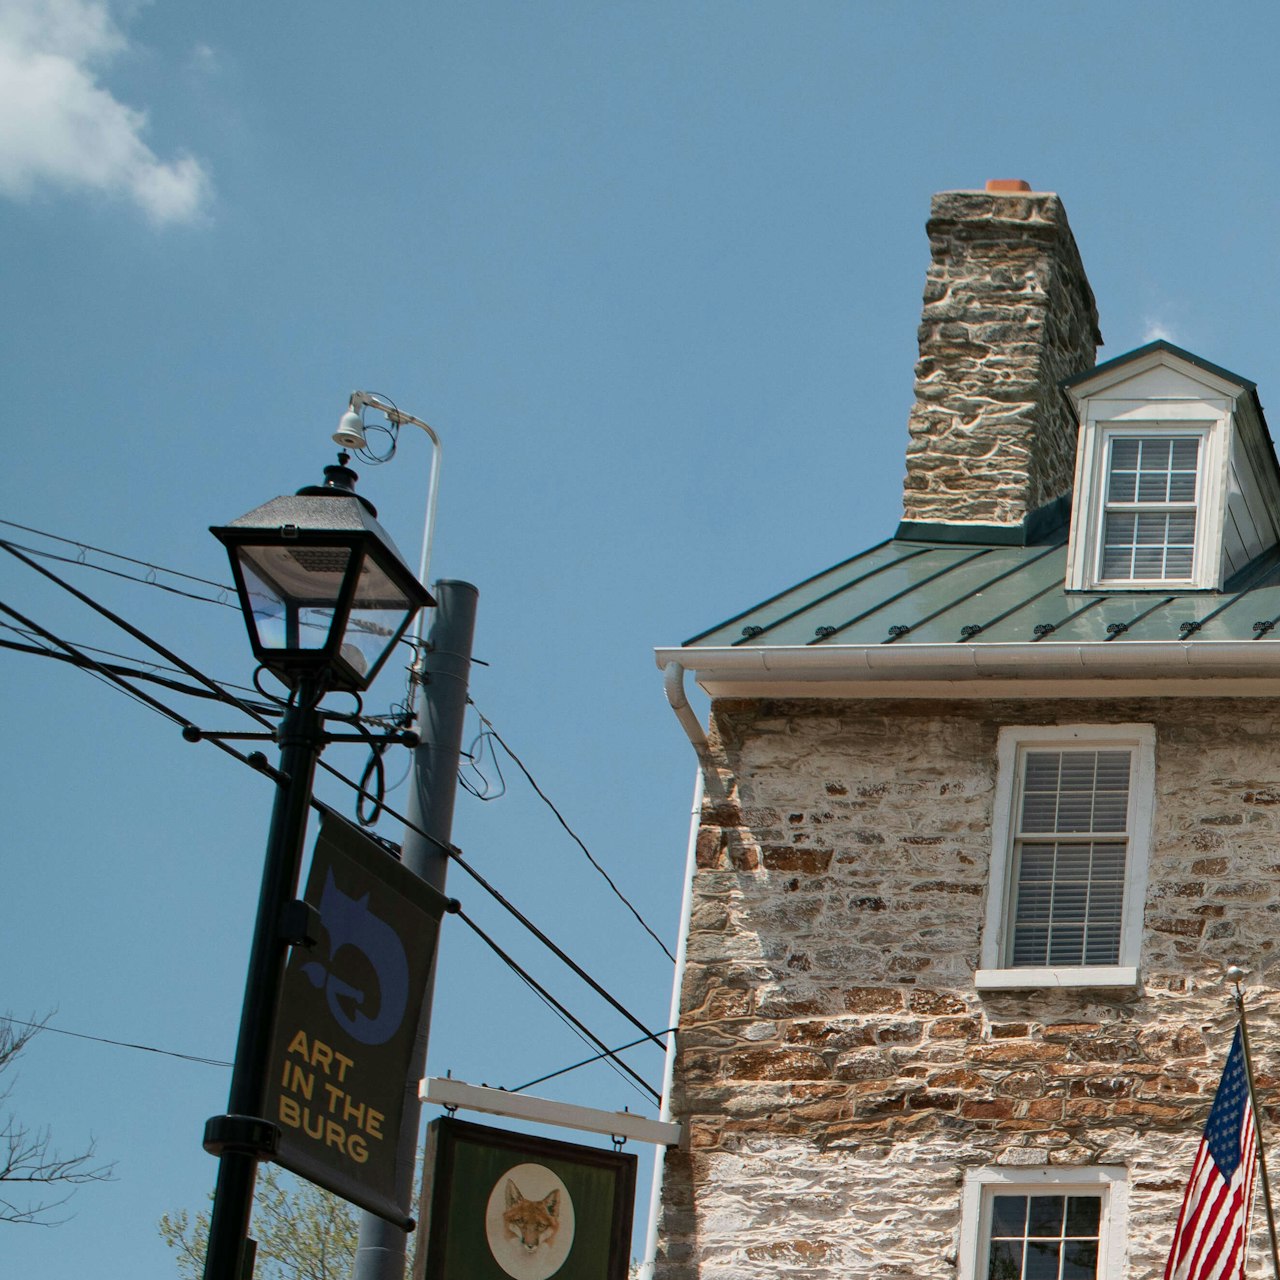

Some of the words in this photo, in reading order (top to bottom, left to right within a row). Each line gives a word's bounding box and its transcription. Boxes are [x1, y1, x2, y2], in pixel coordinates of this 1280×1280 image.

[287, 1030, 354, 1083] ART
[279, 1094, 369, 1164] BURG
[281, 1059, 315, 1101] IN
[324, 1082, 385, 1141] THE
